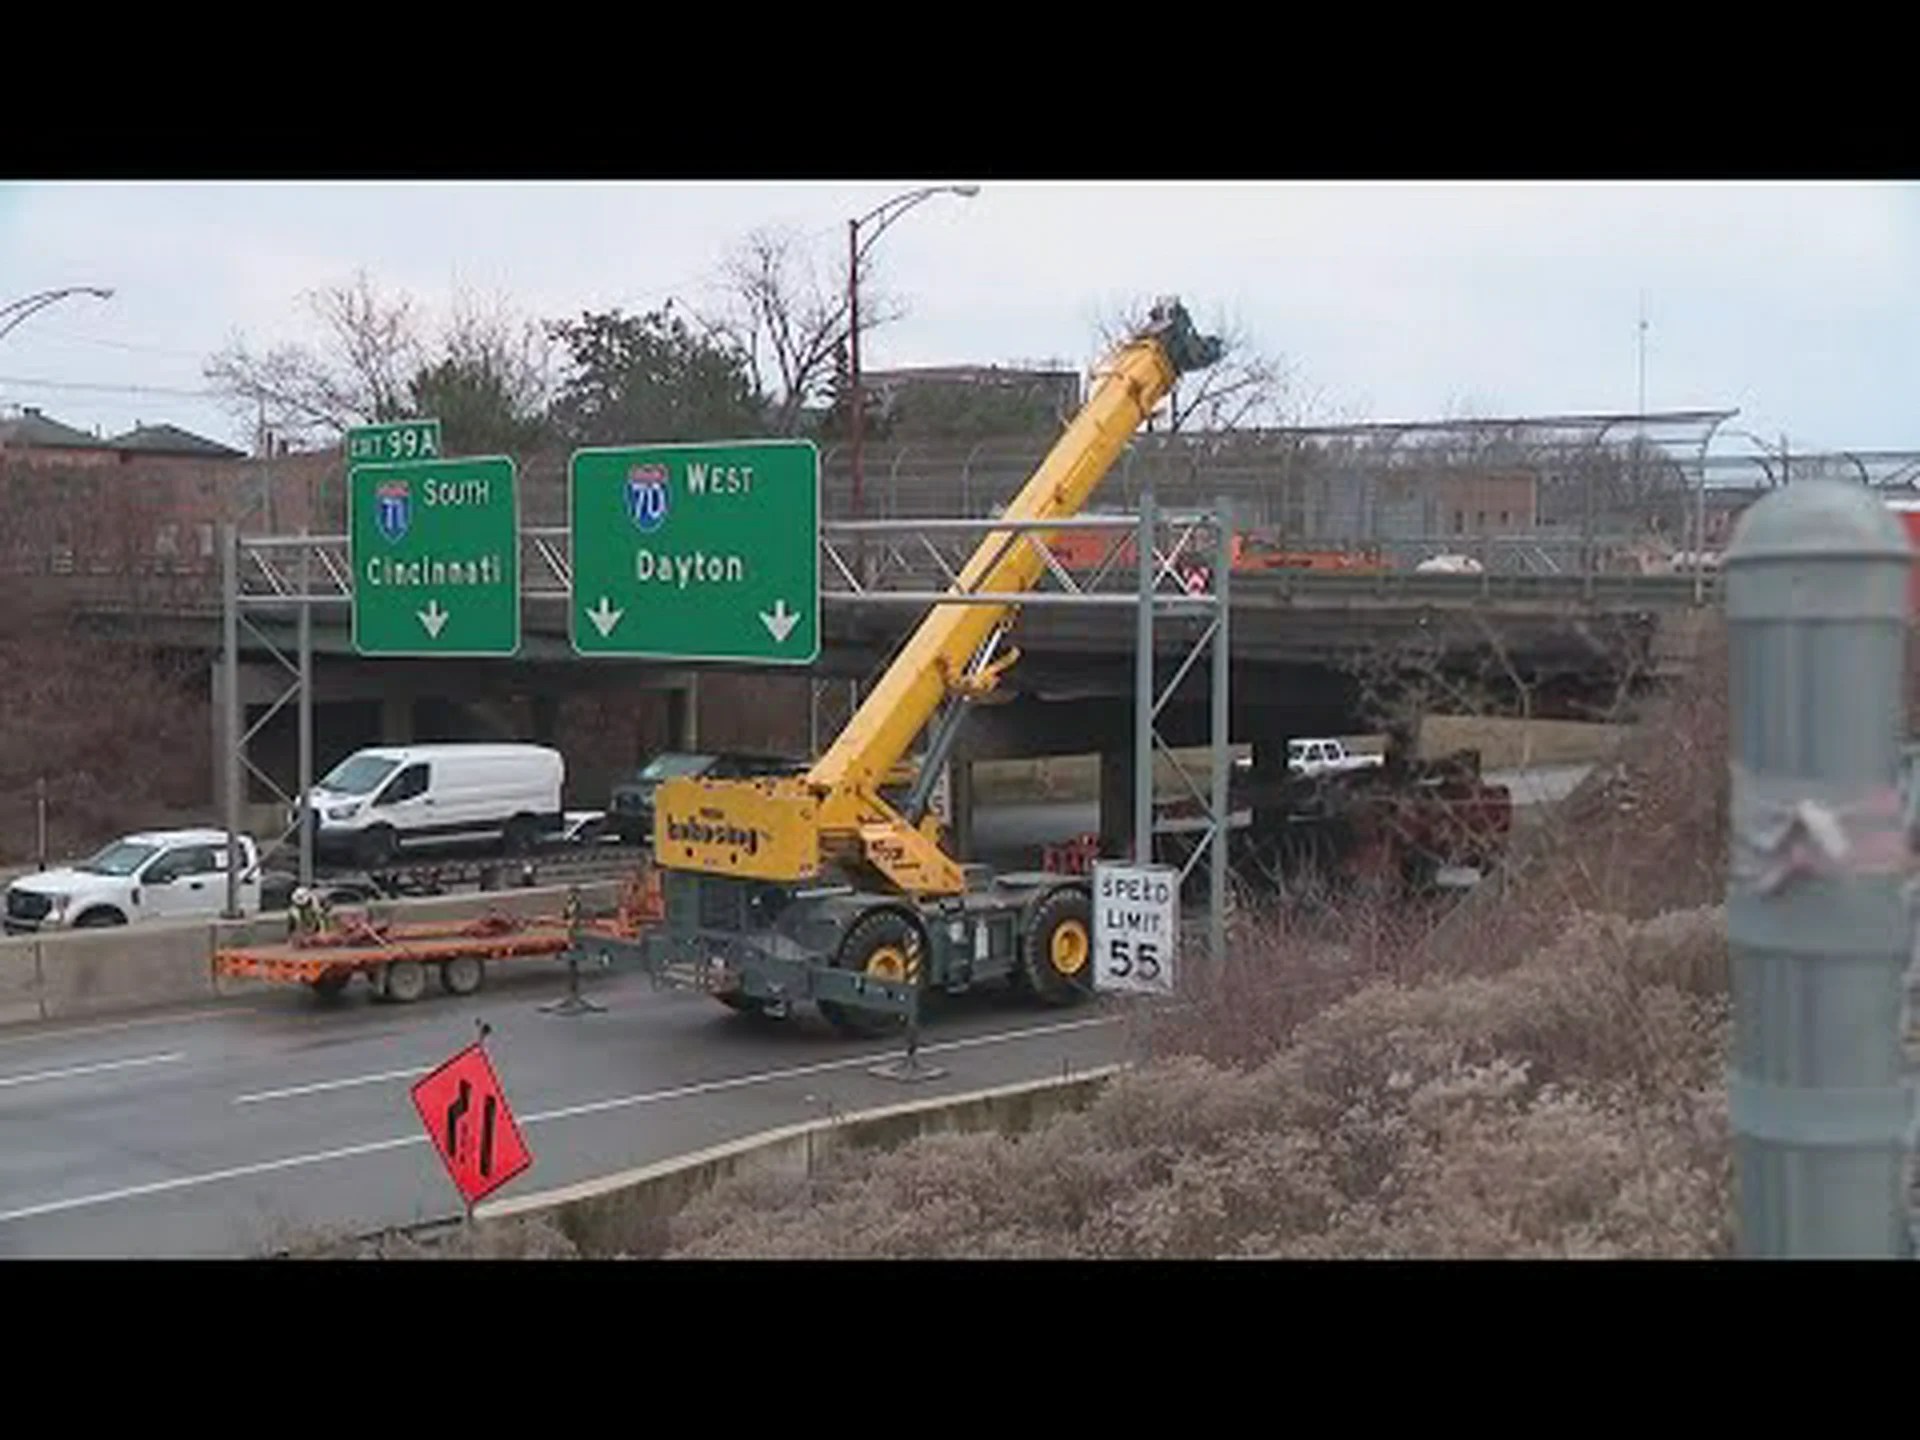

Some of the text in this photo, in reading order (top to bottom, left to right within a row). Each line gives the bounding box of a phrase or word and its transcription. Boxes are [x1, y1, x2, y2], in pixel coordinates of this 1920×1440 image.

[388, 427, 438, 458] 99A
[424, 478, 490, 506] SOUTH
[632, 483, 665, 519] 70
[686, 463, 753, 494] WEST
[367, 555, 502, 585] Cincinnati
[638, 549, 742, 589] Dayton
[1102, 876, 1169, 903] SPEED
[1107, 909, 1160, 932] LIMIT
[1109, 939, 1161, 980] 55
